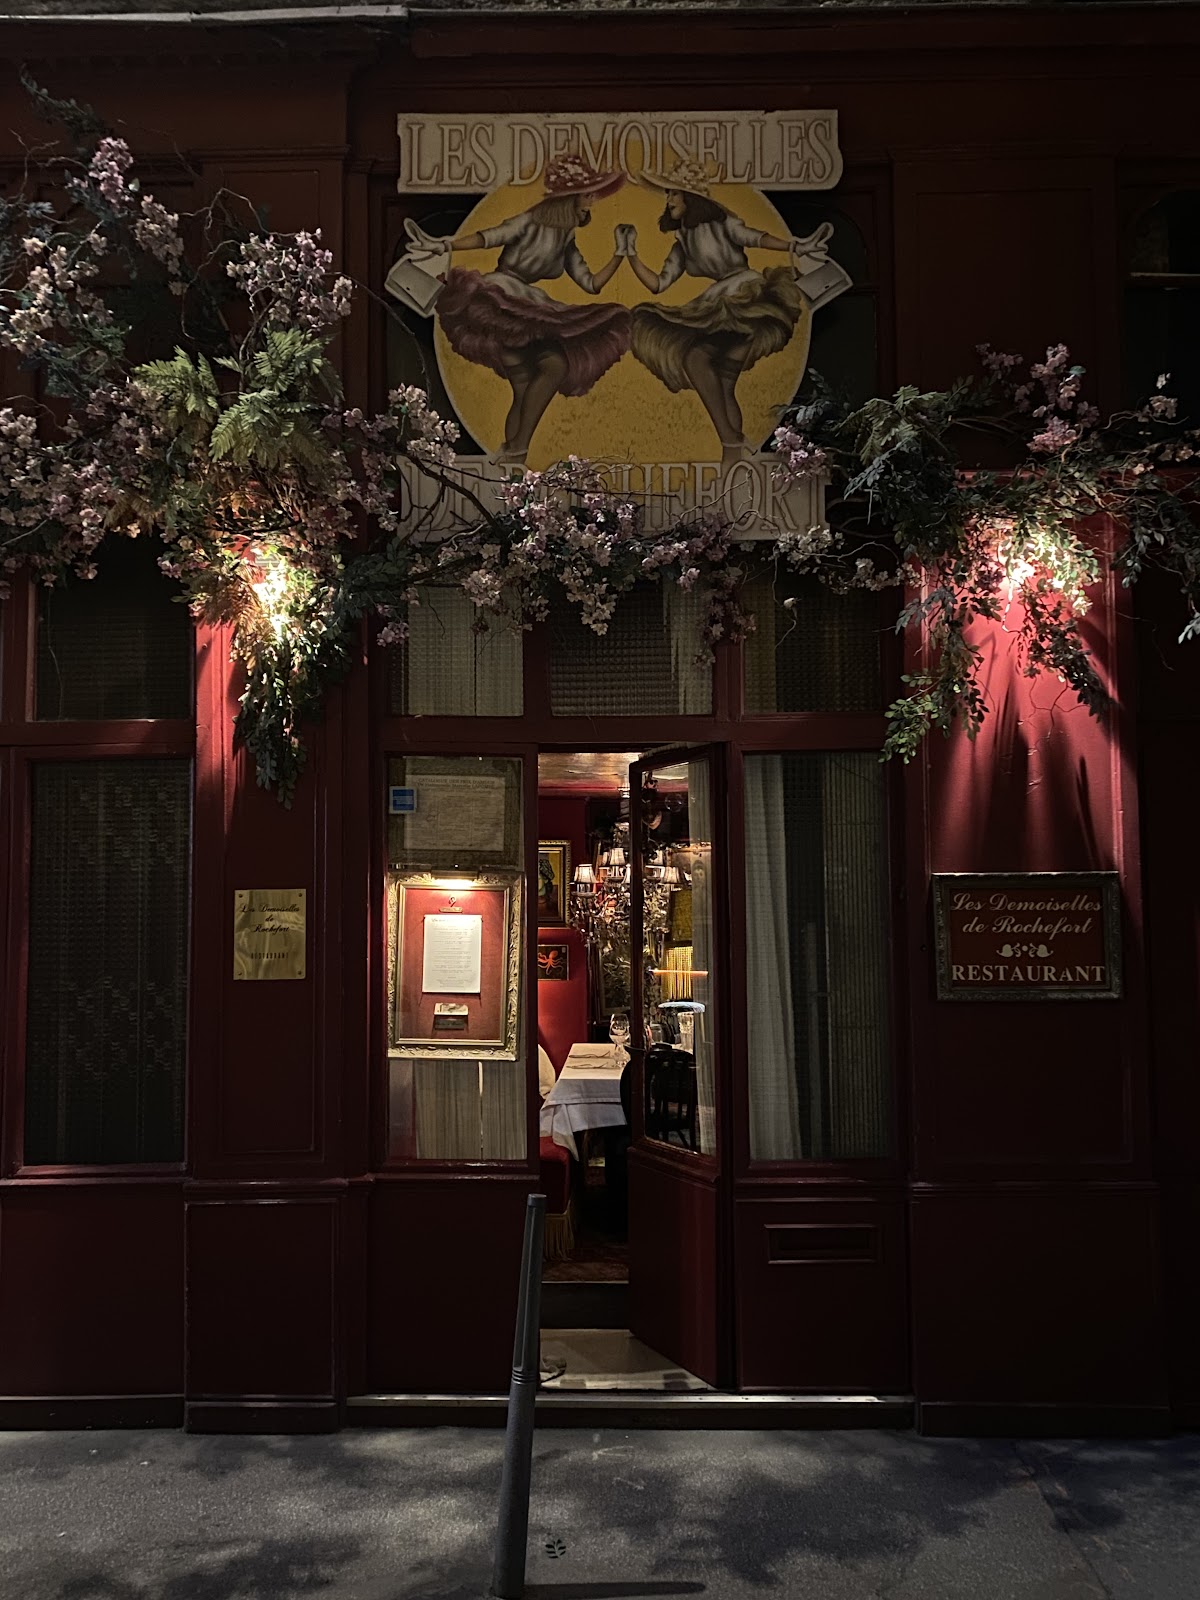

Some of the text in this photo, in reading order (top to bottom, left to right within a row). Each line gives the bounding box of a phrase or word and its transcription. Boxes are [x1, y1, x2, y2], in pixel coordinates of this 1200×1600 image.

[406, 118, 834, 186] LES DEMOISELLES
[240, 903, 299, 912] Les Demoiselles
[950, 892, 1102, 912] Les Demoiselles
[265, 914, 274, 922] de
[962, 915, 1093, 940] de Rochefort
[252, 924, 289, 934] Rochefort
[951, 964, 1106, 983] RESTAURANT
